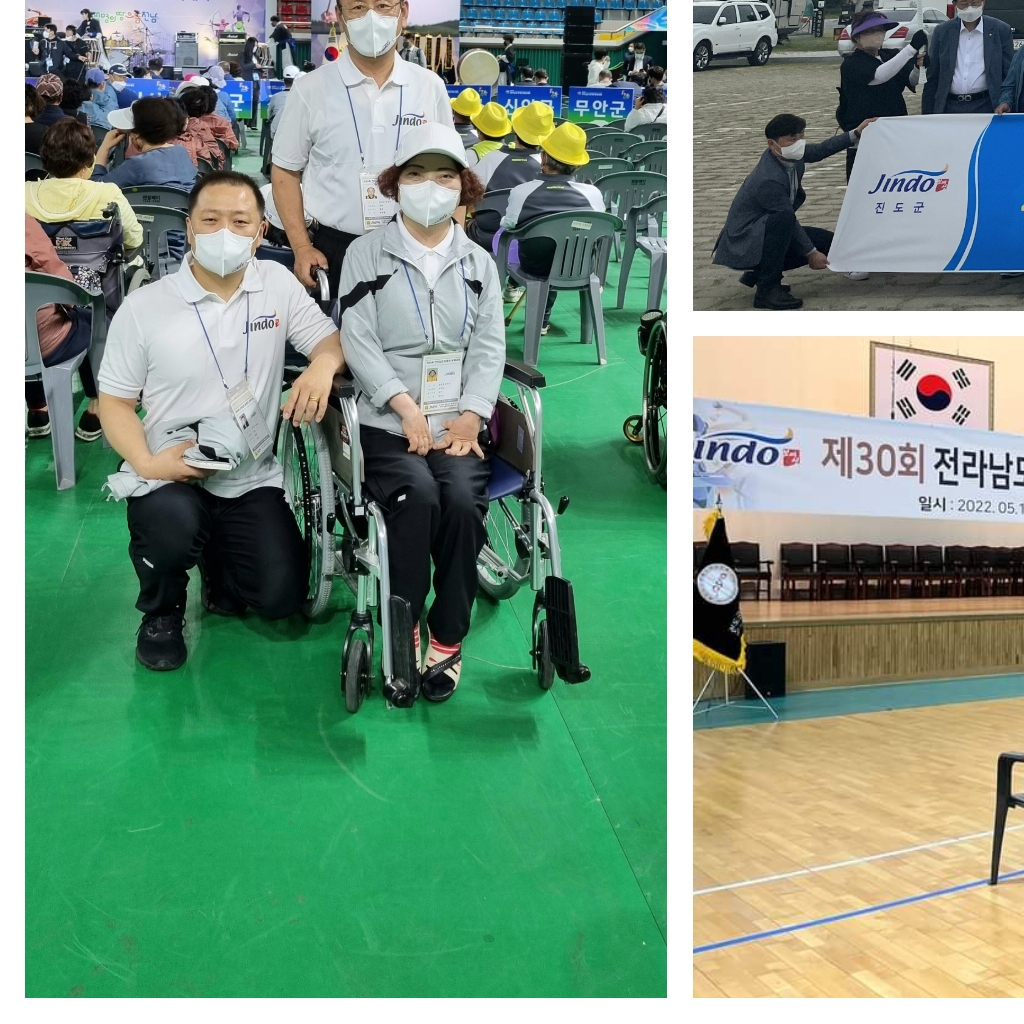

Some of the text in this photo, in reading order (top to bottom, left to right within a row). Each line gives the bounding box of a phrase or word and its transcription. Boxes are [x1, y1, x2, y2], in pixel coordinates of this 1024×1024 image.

[574, 99, 626, 119] 무안군
[392, 113, 422, 127] Jindo
[868, 173, 936, 195] Jindo
[243, 318, 275, 335] Jindo
[693, 438, 779, 467] indo
[821, 436, 925, 484] 제30회
[918, 496, 947, 512] 일시
